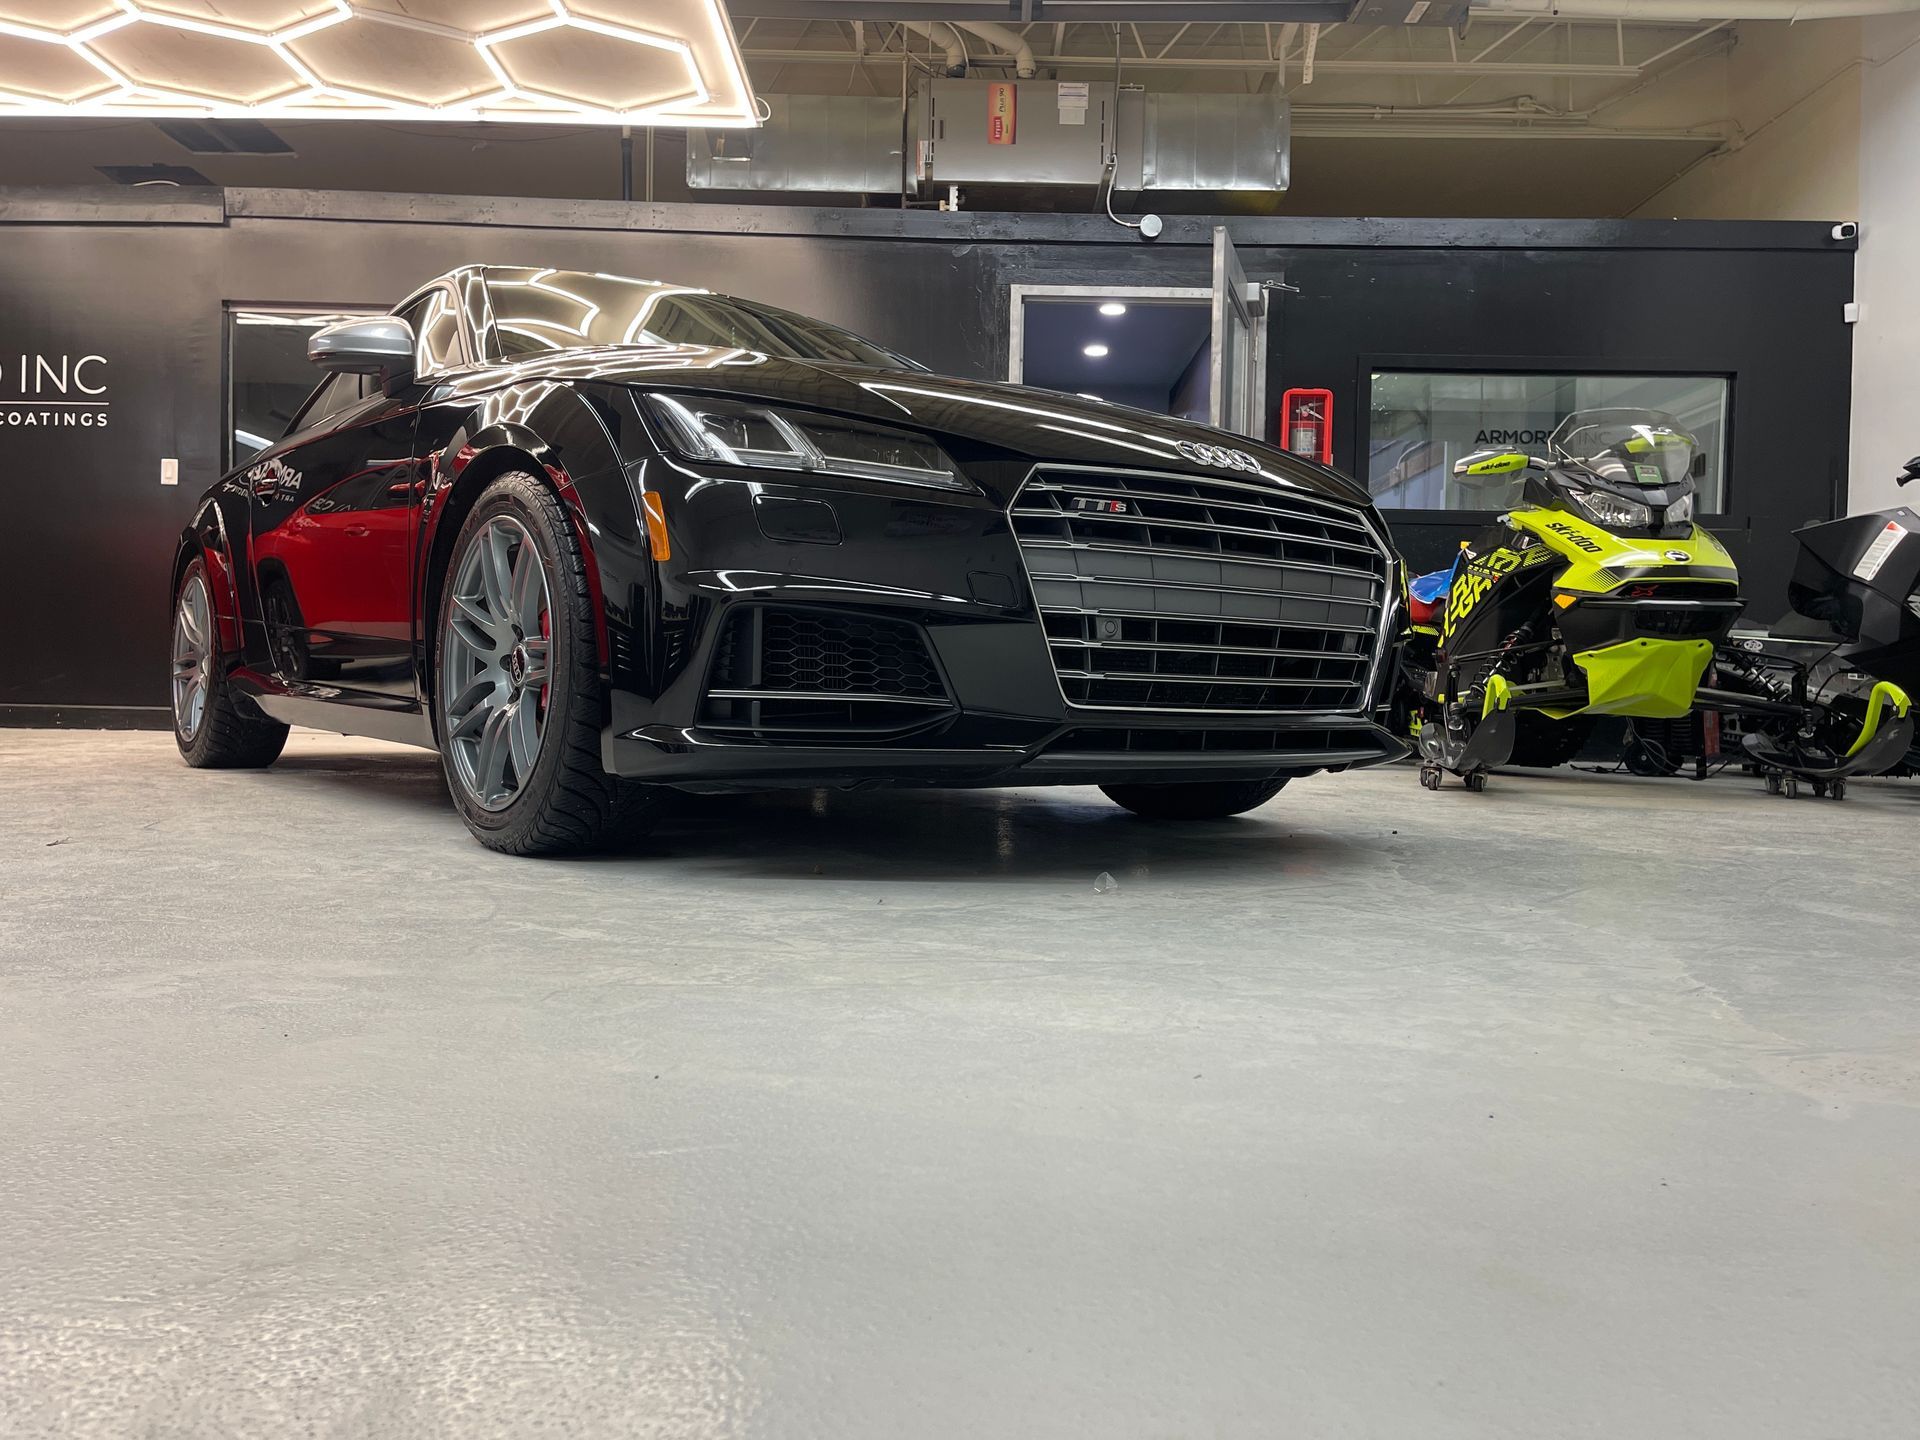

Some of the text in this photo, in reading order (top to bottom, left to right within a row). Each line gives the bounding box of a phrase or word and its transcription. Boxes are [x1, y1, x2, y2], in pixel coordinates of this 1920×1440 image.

[21, 354, 108, 395] INC
[1474, 430, 1611, 445] ARMOR INC
[1545, 522, 1603, 552] ski-doo
